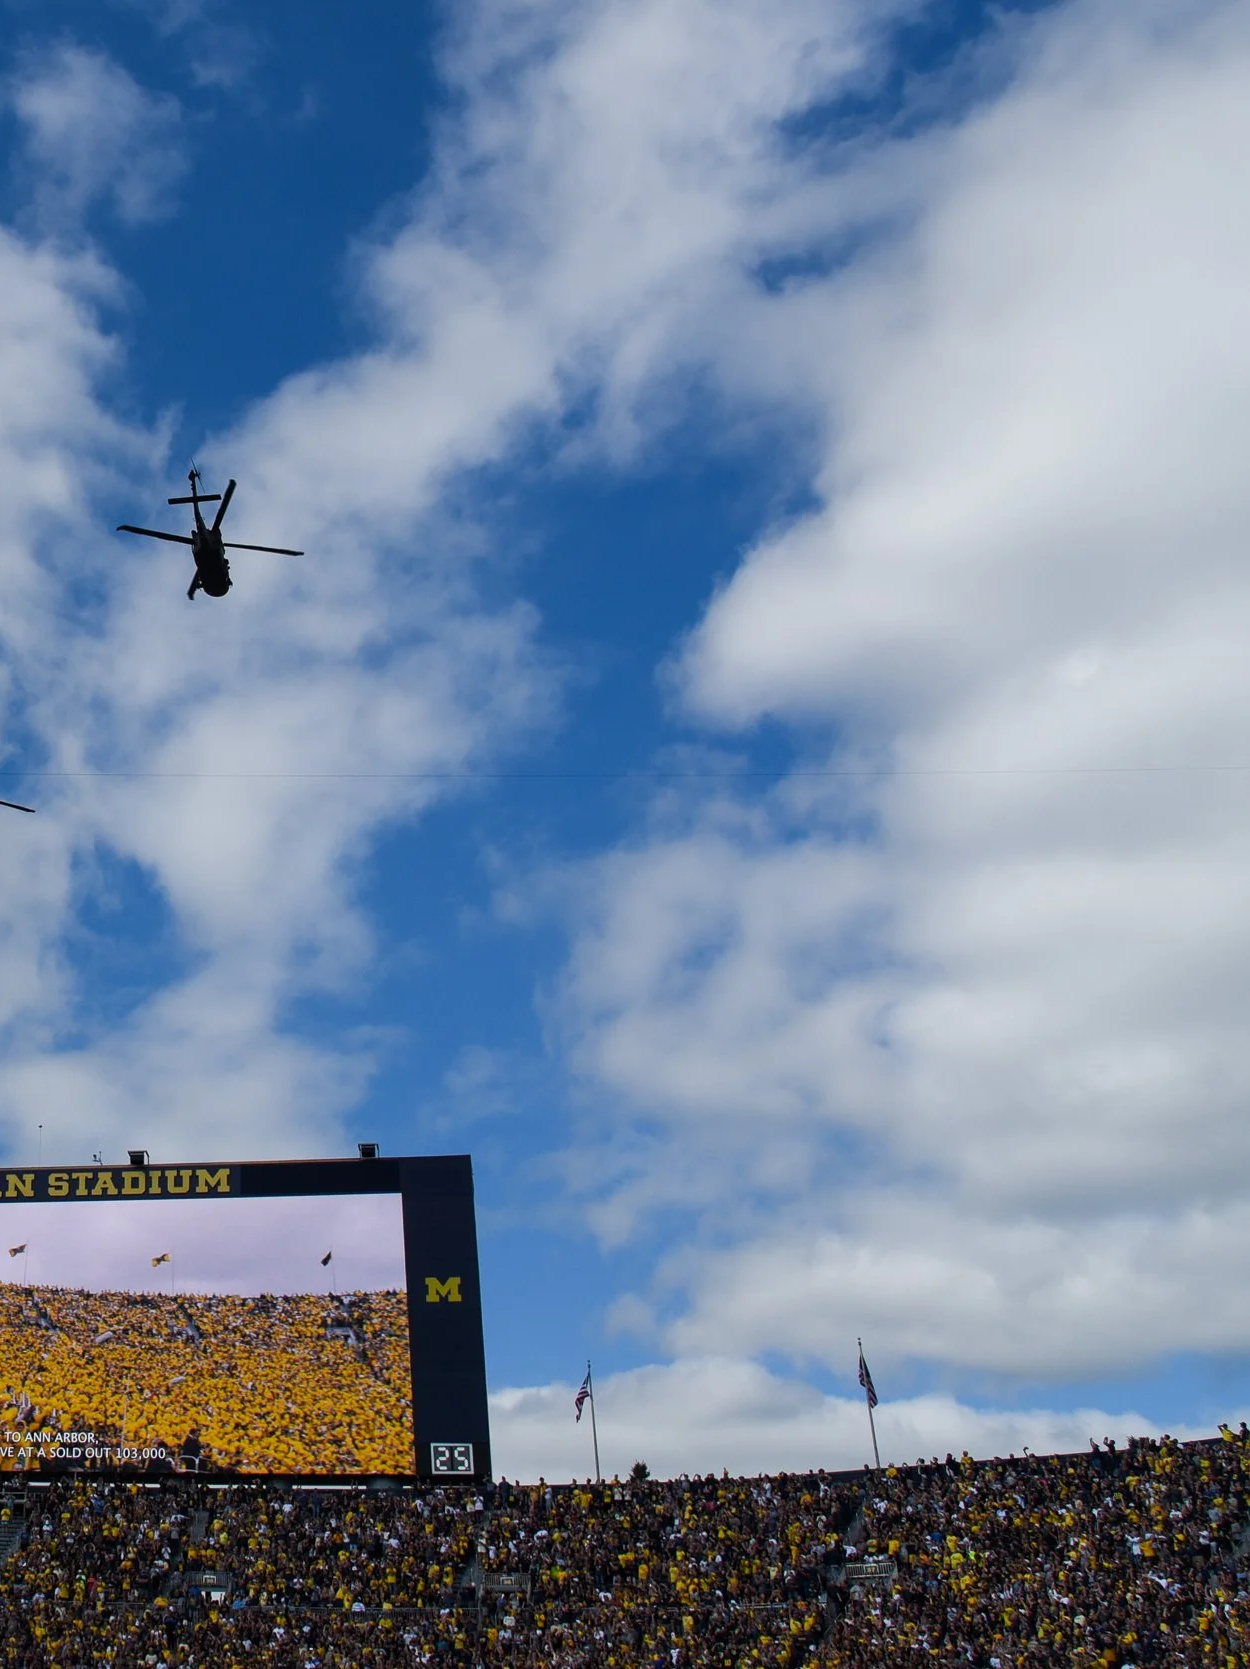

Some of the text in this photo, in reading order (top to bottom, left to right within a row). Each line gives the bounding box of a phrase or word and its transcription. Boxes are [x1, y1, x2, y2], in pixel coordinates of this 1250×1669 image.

[47, 1167, 232, 1197] STADIUM
[424, 1276, 462, 1303] M
[4, 1431, 22, 1443] TO
[24, 1431, 51, 1443] ANN
[17, 1446, 35, 1458] AT
[36, 1446, 47, 1458] A
[49, 1446, 82, 1459] SOLD
[84, 1447, 112, 1459] OUT
[115, 1447, 167, 1461] 103,000
[435, 1446, 469, 1470] 25
